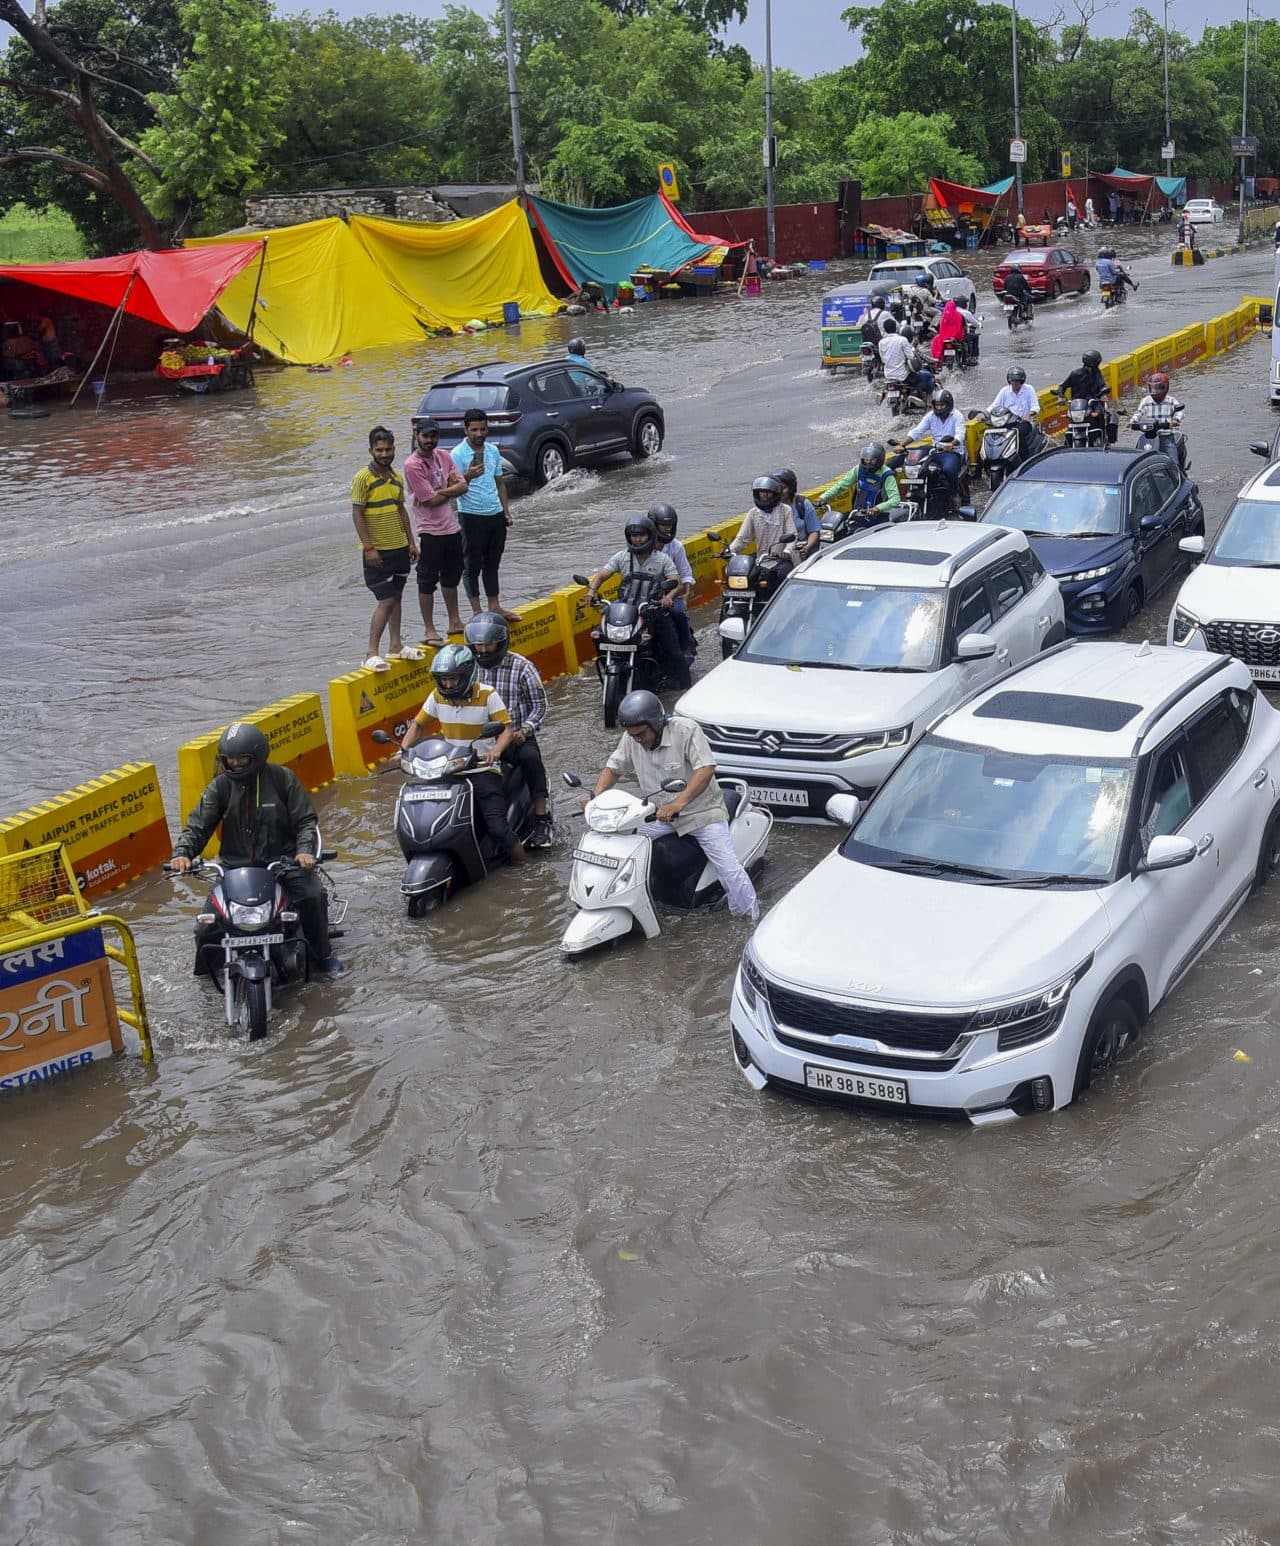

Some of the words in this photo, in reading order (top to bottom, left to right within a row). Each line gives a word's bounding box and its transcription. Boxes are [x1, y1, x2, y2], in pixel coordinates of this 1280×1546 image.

[292, 709, 320, 729] POLICE
[41, 819, 77, 844] JAIPUR
[78, 799, 119, 826] TRAFFIC
[121, 783, 155, 806] POLICE
[89, 814, 119, 835] TRAFFIC
[121, 801, 145, 818] RULES
[86, 858, 116, 881] kotak
[816, 1072, 833, 1089] HR
[836, 1076, 854, 1093] 98
[856, 1080, 865, 1095] B
[868, 1082, 904, 1101] 5889
